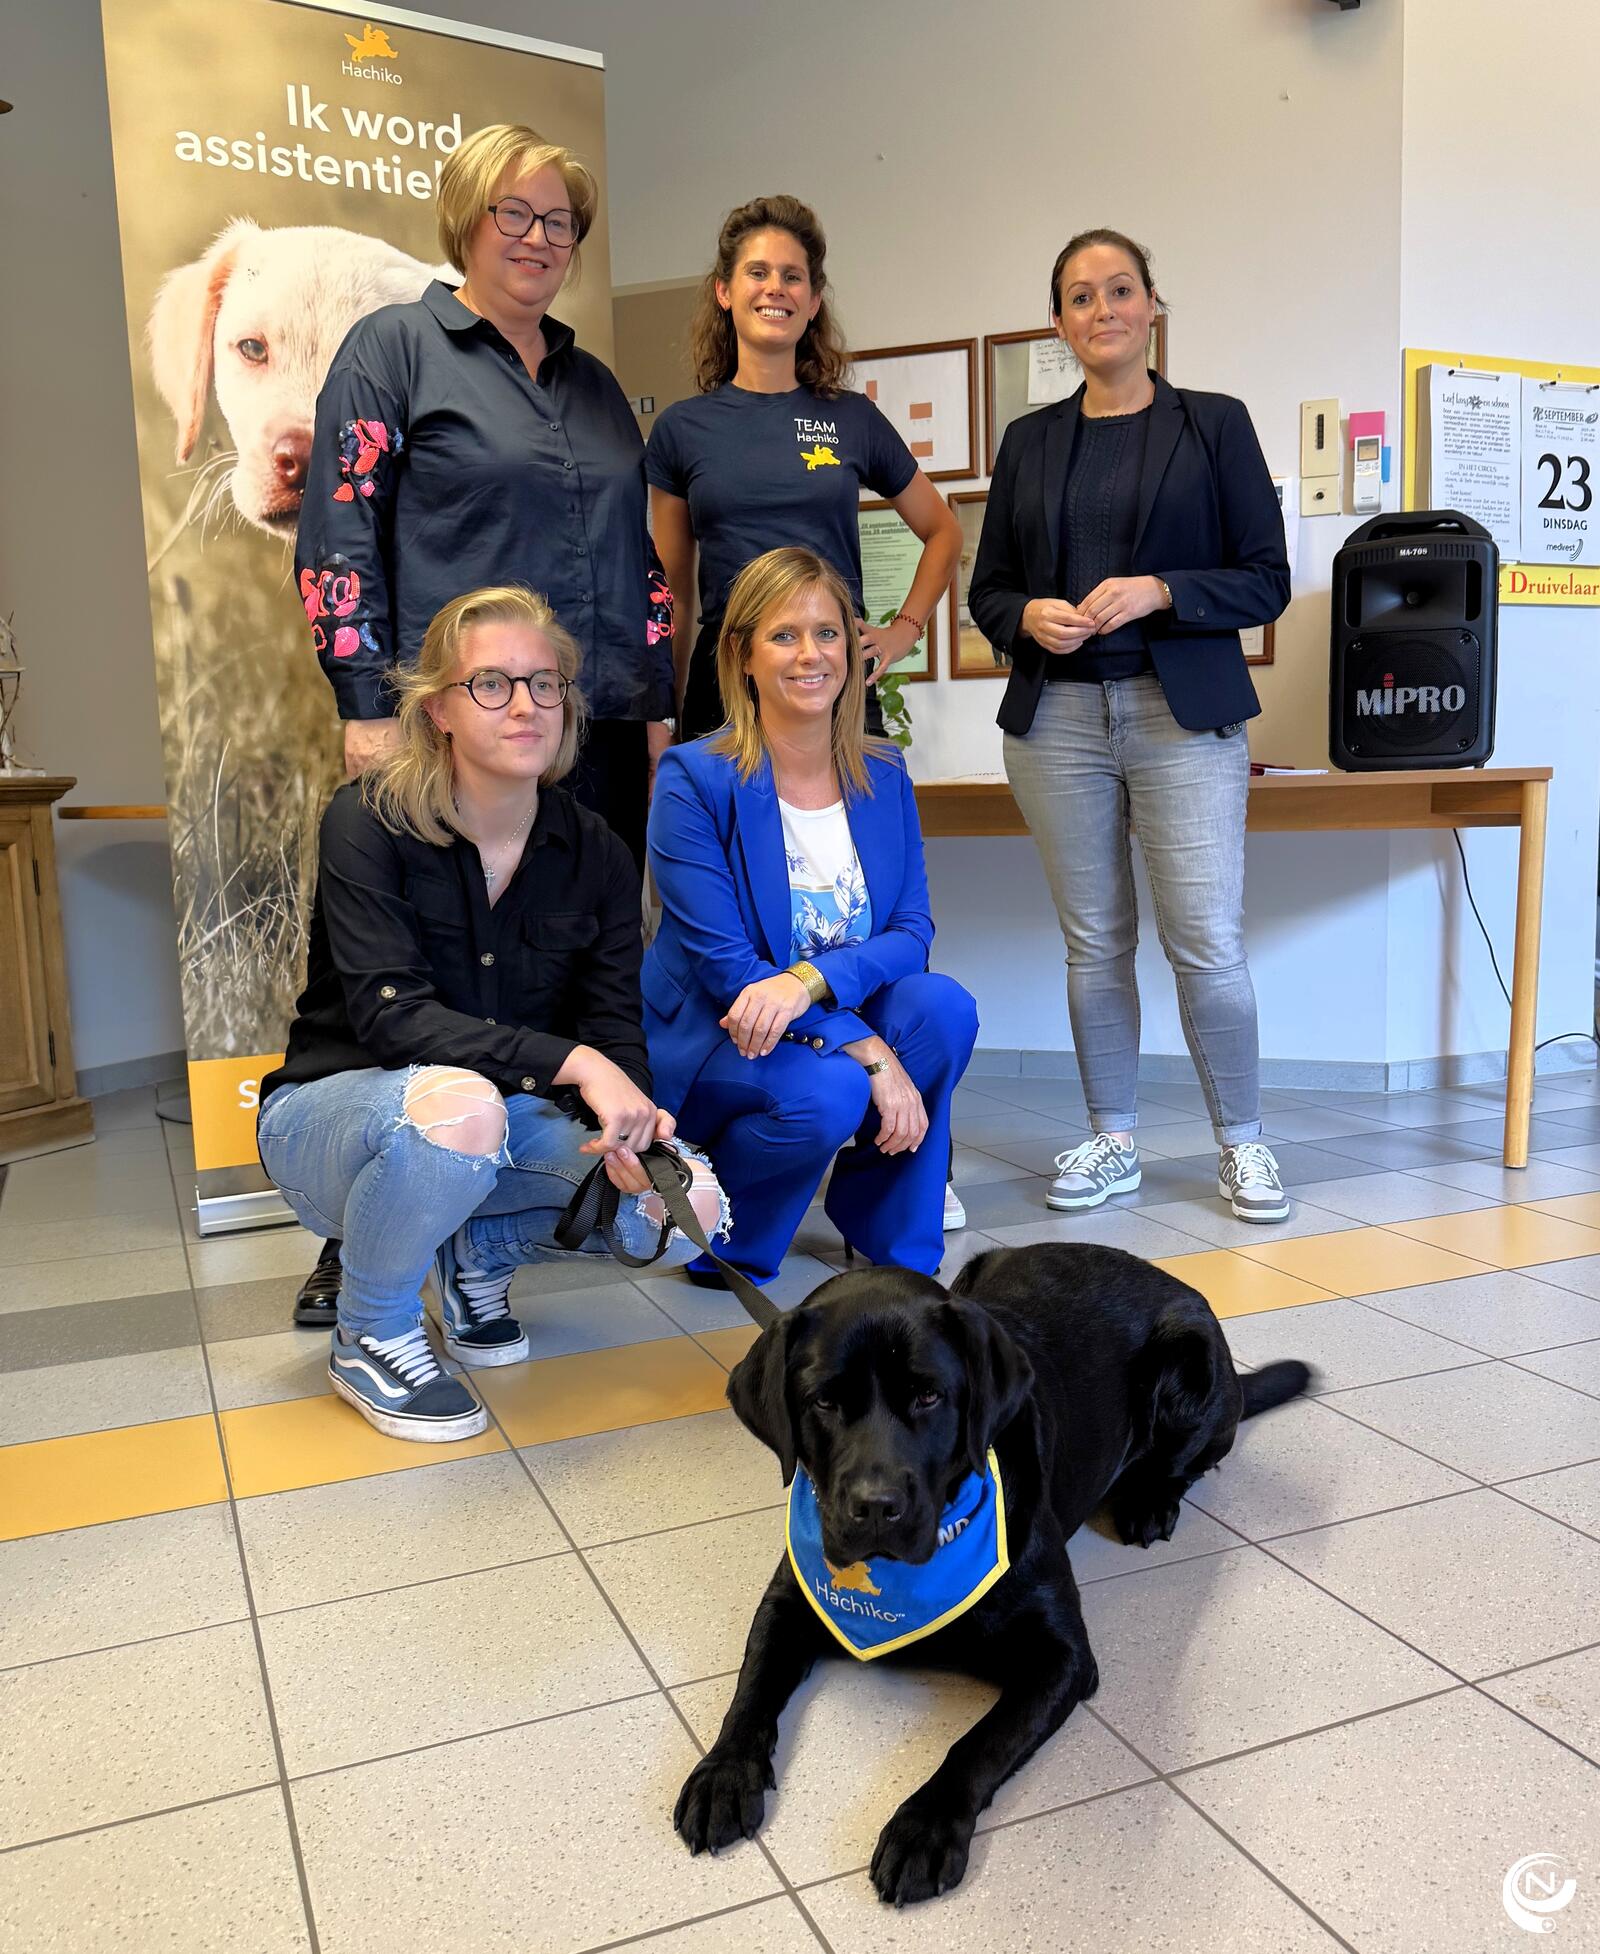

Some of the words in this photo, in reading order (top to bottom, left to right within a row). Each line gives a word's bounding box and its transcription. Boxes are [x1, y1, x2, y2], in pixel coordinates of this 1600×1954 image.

[341, 60, 403, 85] Hachiko
[286, 83, 331, 132] Ik
[341, 106, 463, 155] word
[1544, 409, 1585, 422] SEPTEMBER
[794, 418, 836, 434] TEAM
[796, 432, 840, 444] Hachiko
[1537, 453, 1592, 512] 23
[1543, 517, 1588, 531] DINSDAG
[1509, 571, 1600, 595] Druivelaar
